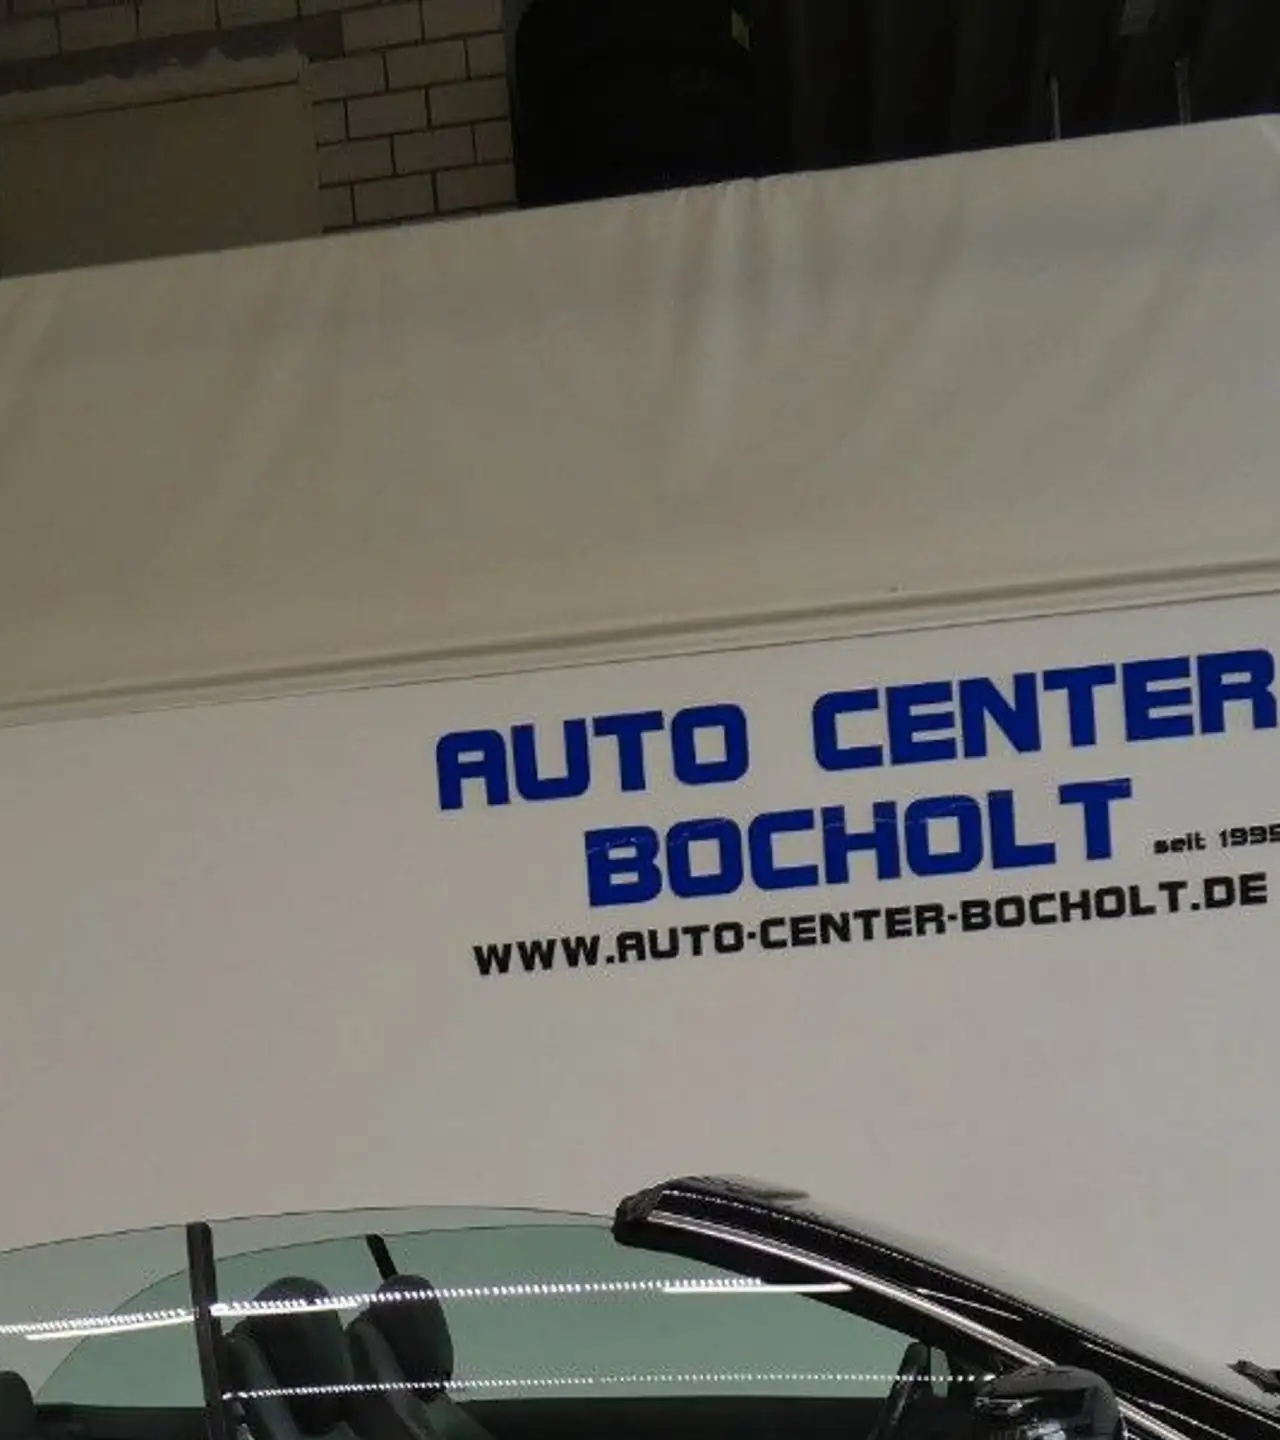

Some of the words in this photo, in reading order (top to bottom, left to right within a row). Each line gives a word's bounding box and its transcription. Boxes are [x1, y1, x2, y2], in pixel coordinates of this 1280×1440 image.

[437, 703, 749, 810] AUTO
[812, 648, 1279, 773] CENTER
[584, 777, 1133, 907] BOCHOLT
[1152, 831, 1208, 856] seit
[472, 871, 1269, 977] WWW.AUTO-CENTER-BOCHOLT.DE
